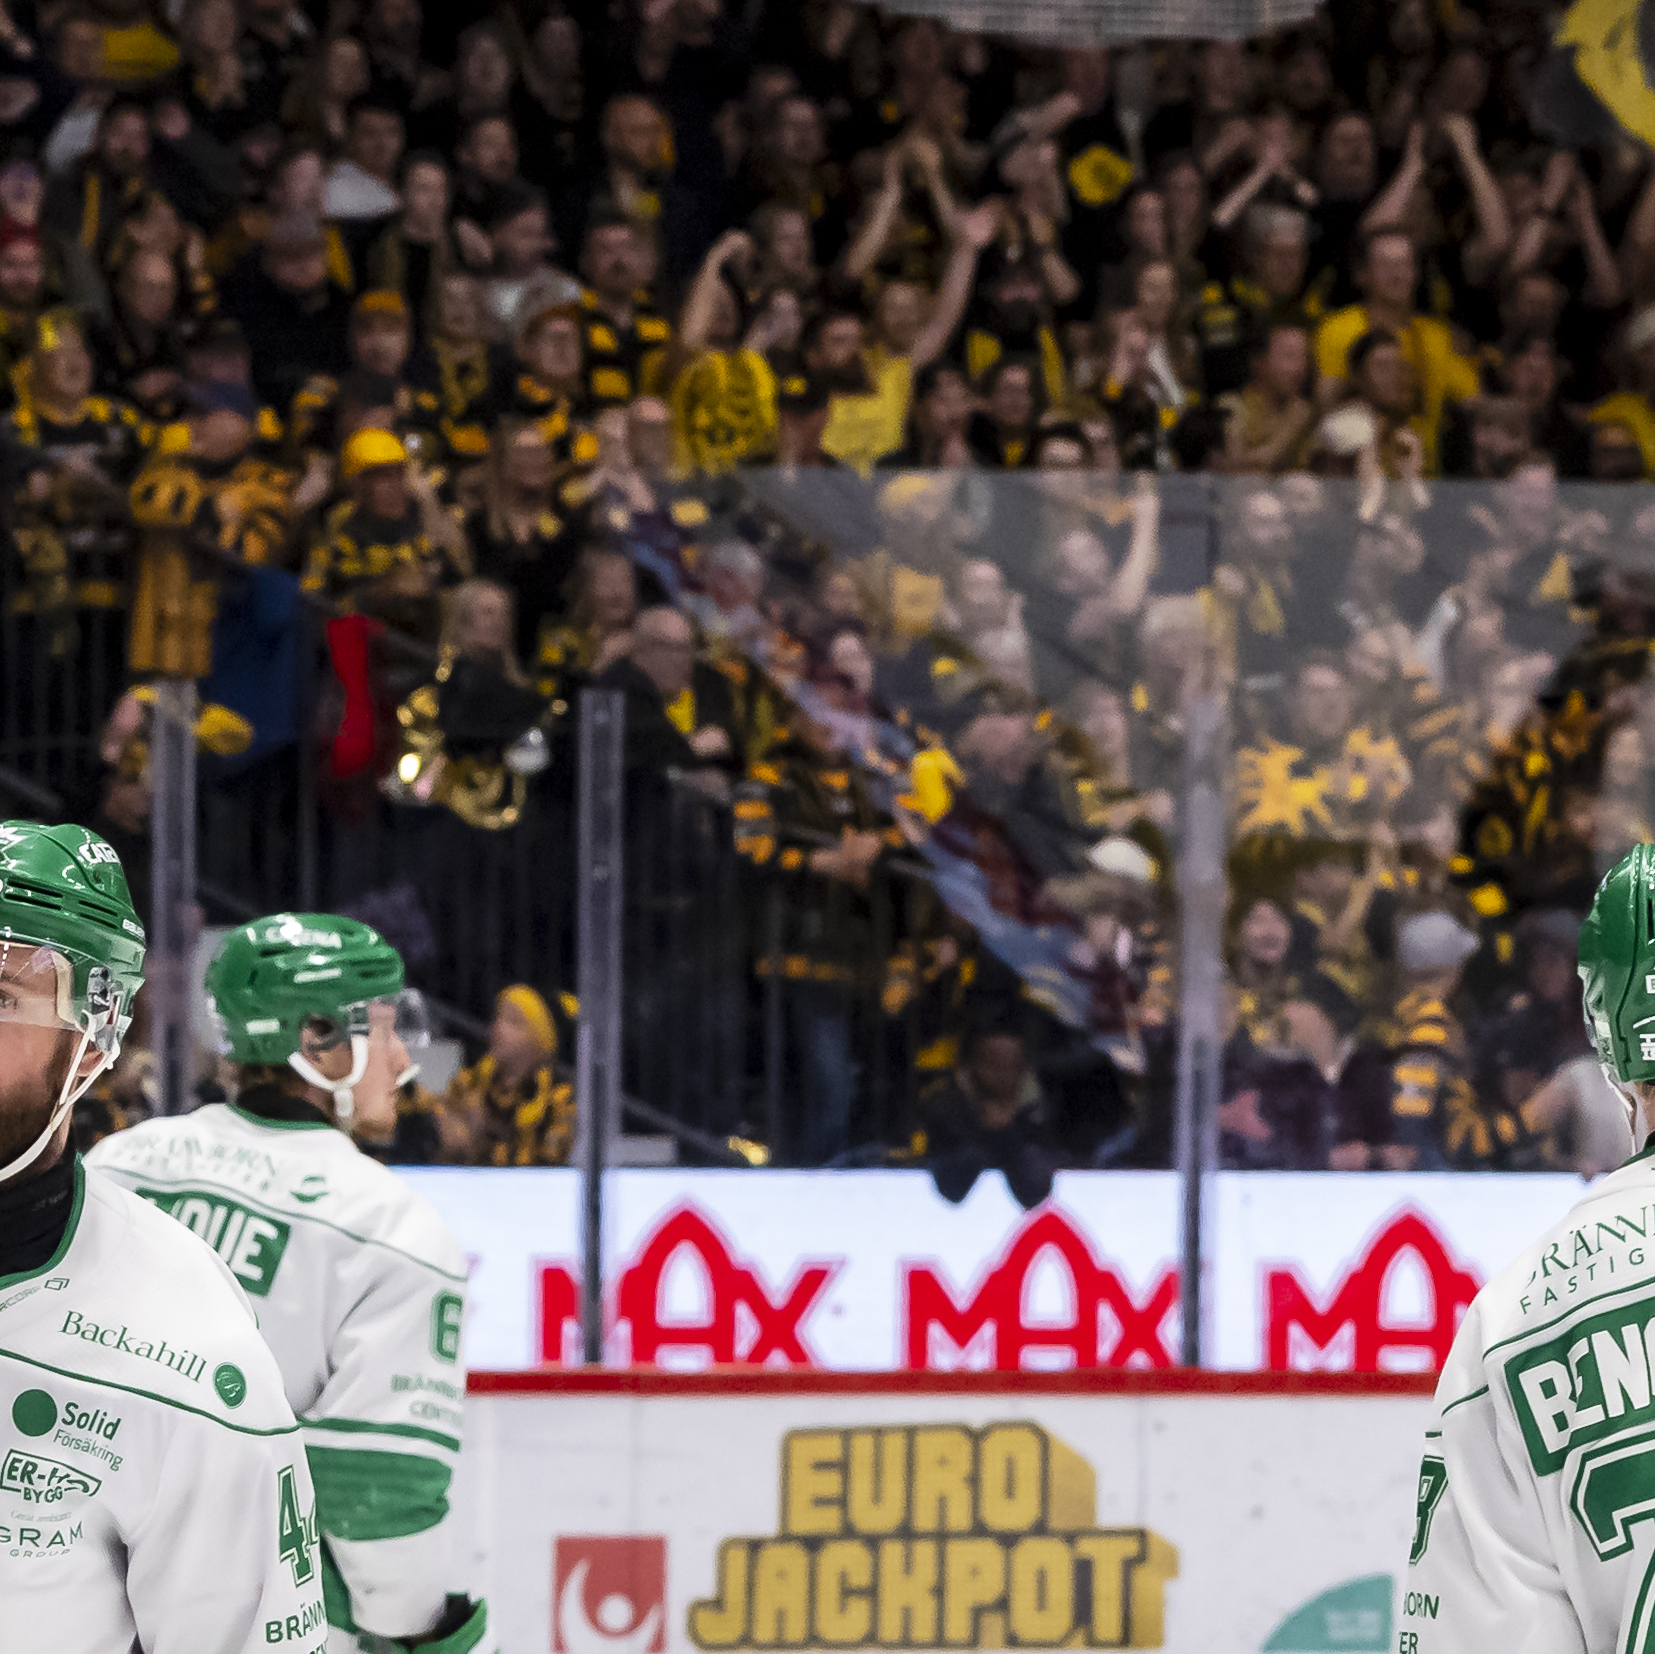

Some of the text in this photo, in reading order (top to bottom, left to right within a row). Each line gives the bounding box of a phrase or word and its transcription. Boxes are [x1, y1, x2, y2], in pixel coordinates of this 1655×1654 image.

[533, 1200, 848, 1370] MAX
[901, 1198, 1182, 1370] MAX
[1259, 1200, 1480, 1370] MA
[59, 1310, 207, 1384] Backahill
[53, 1429, 124, 1472] Försäkring
[61, 1402, 122, 1441] Solid
[23, 1486, 64, 1503] BYGG
[780, 1420, 1046, 1534] EURO
[10, 1549, 71, 1558] GROUP
[687, 1529, 1148, 1652] JACKPOT
[1403, 1591, 1440, 1620] ORN
